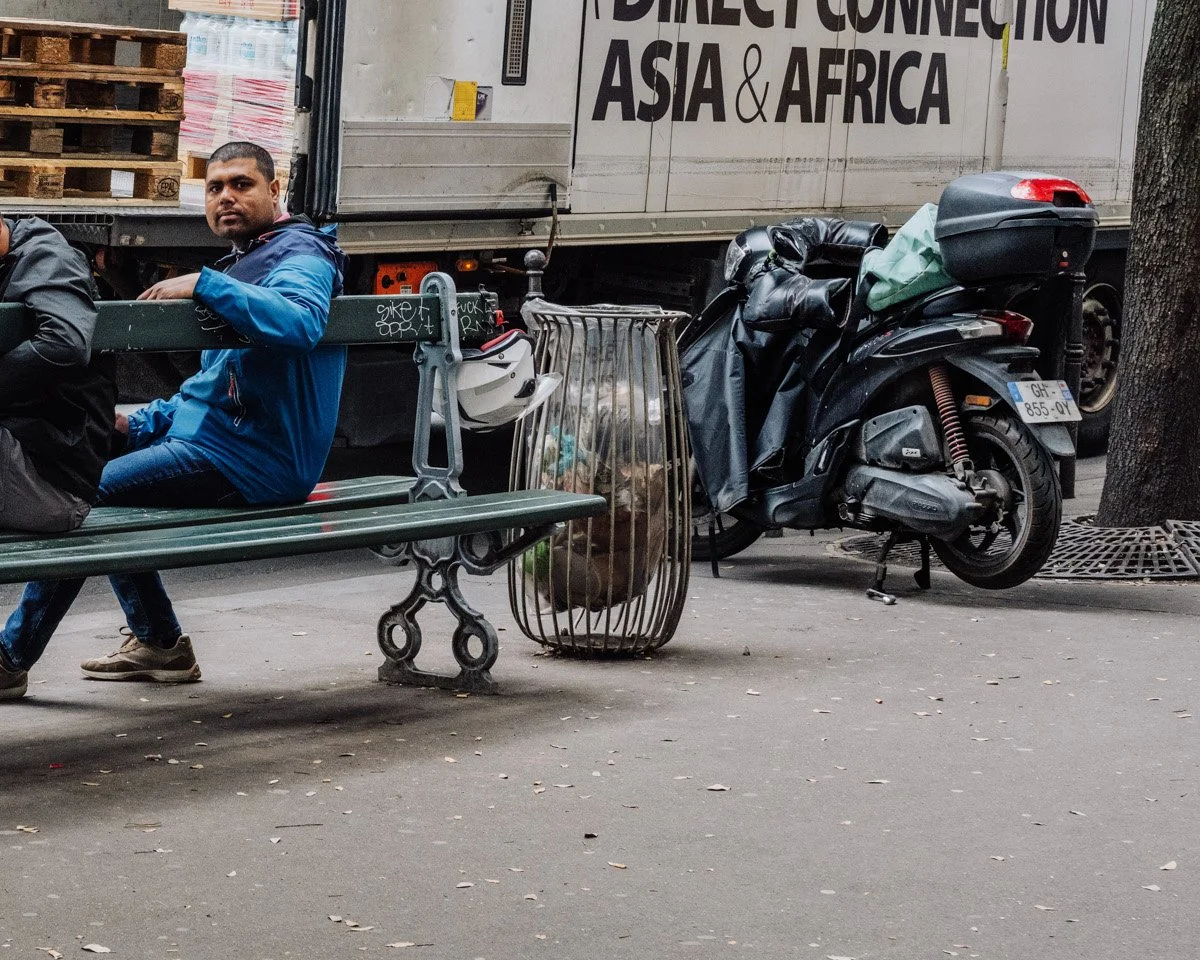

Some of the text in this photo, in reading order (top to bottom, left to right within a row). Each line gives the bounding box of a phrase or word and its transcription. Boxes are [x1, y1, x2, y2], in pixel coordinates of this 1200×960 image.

[591, 38, 951, 126] ASIA & AFRICA
